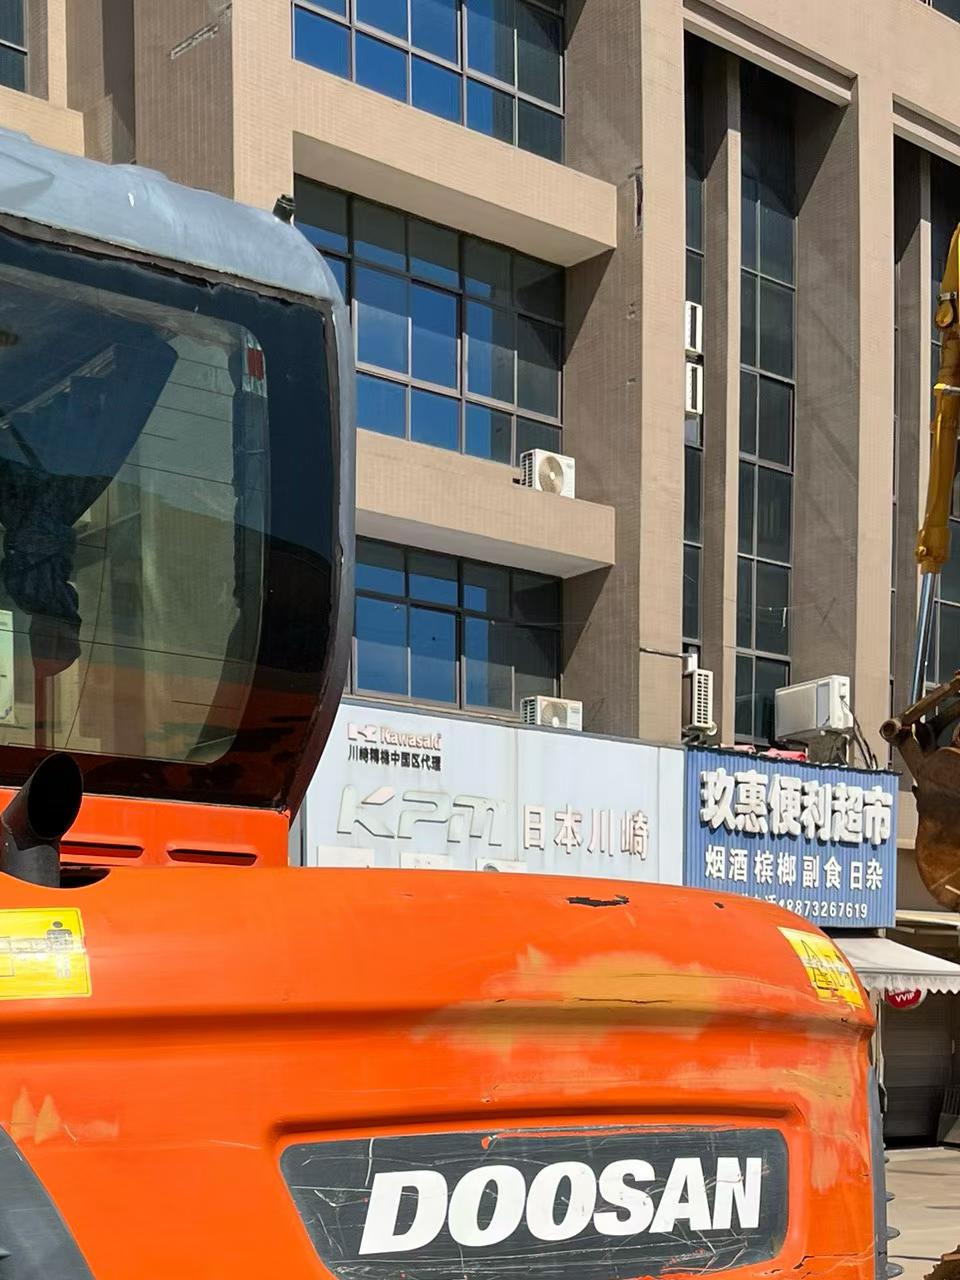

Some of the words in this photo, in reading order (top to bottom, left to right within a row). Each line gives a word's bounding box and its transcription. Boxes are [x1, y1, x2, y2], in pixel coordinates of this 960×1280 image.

[379, 726, 442, 751] Kawasaki
[523, 803, 649, 861] 日本川崎
[699, 767, 895, 847] 玖惠便利超市
[704, 844, 749, 883] 烟酒
[754, 849, 798, 887] 槟榔
[802, 854, 843, 890] 副食
[849, 857, 884, 891] 日杂
[358, 1156, 763, 1256] DOOSAN
